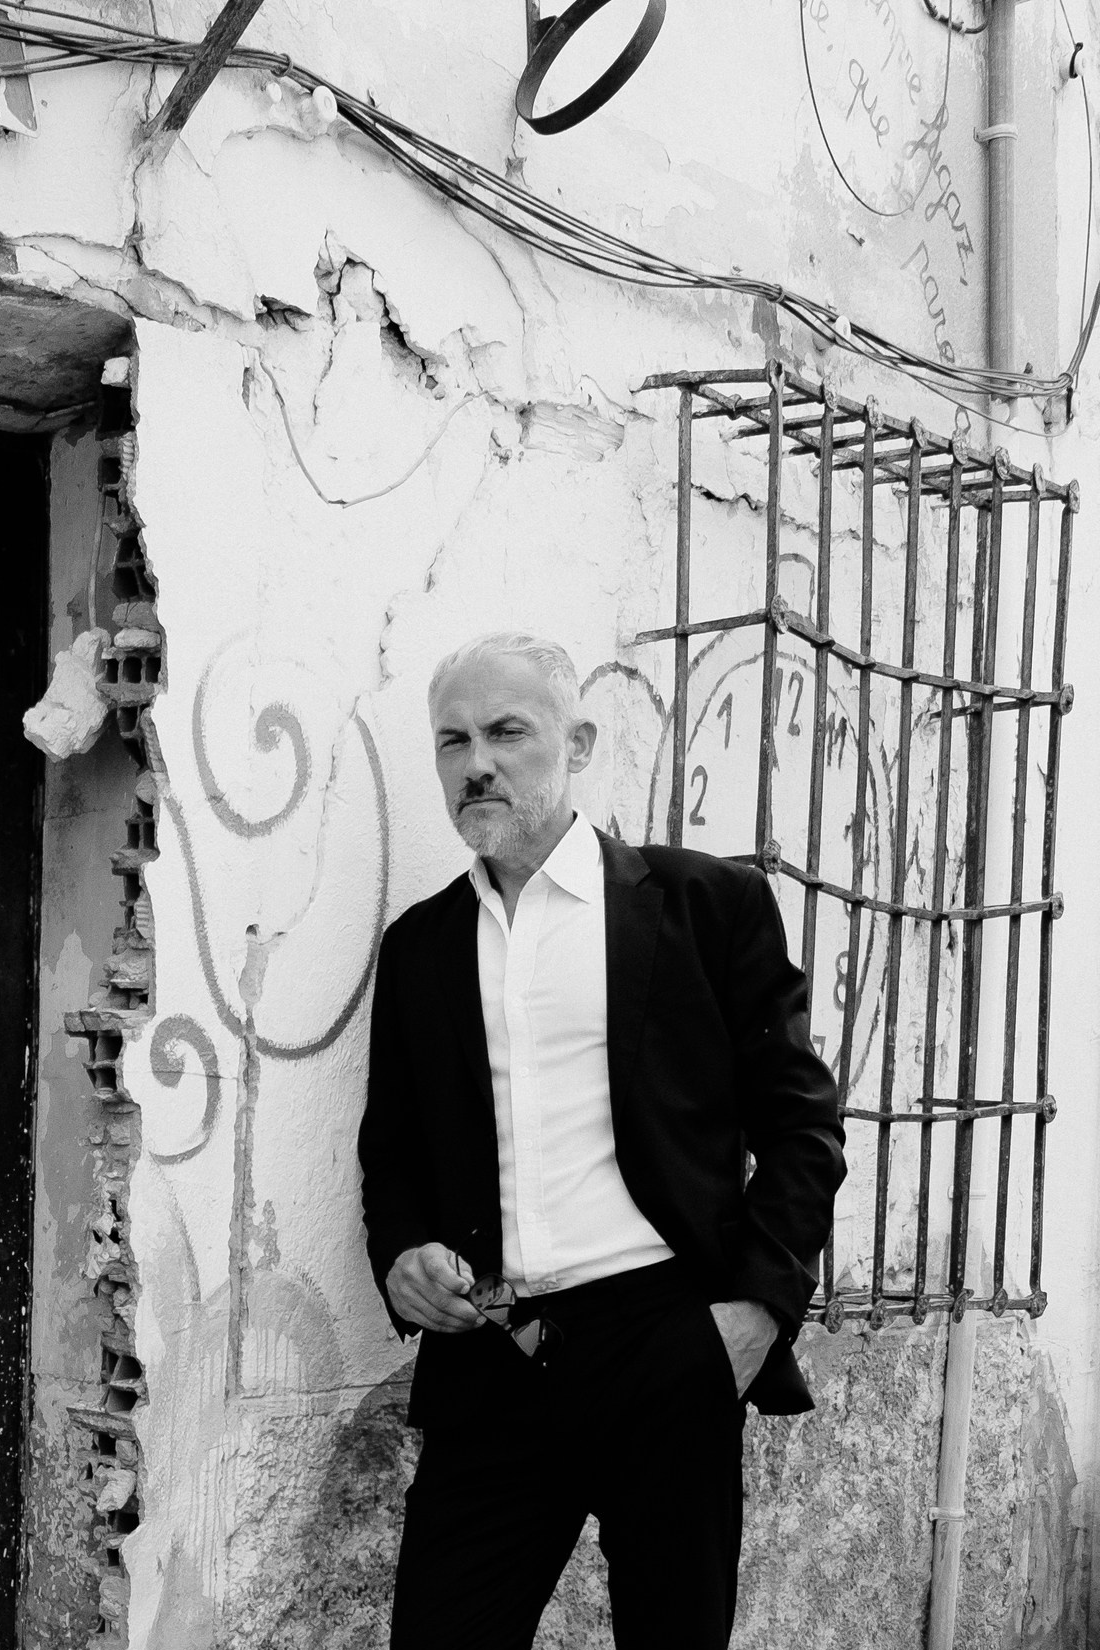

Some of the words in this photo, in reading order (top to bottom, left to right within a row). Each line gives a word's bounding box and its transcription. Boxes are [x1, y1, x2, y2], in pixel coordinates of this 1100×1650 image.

[846, 58, 890, 148] que
[716, 692, 733, 750] 1
[771, 667, 804, 737] 12
[689, 764, 708, 826] 2
